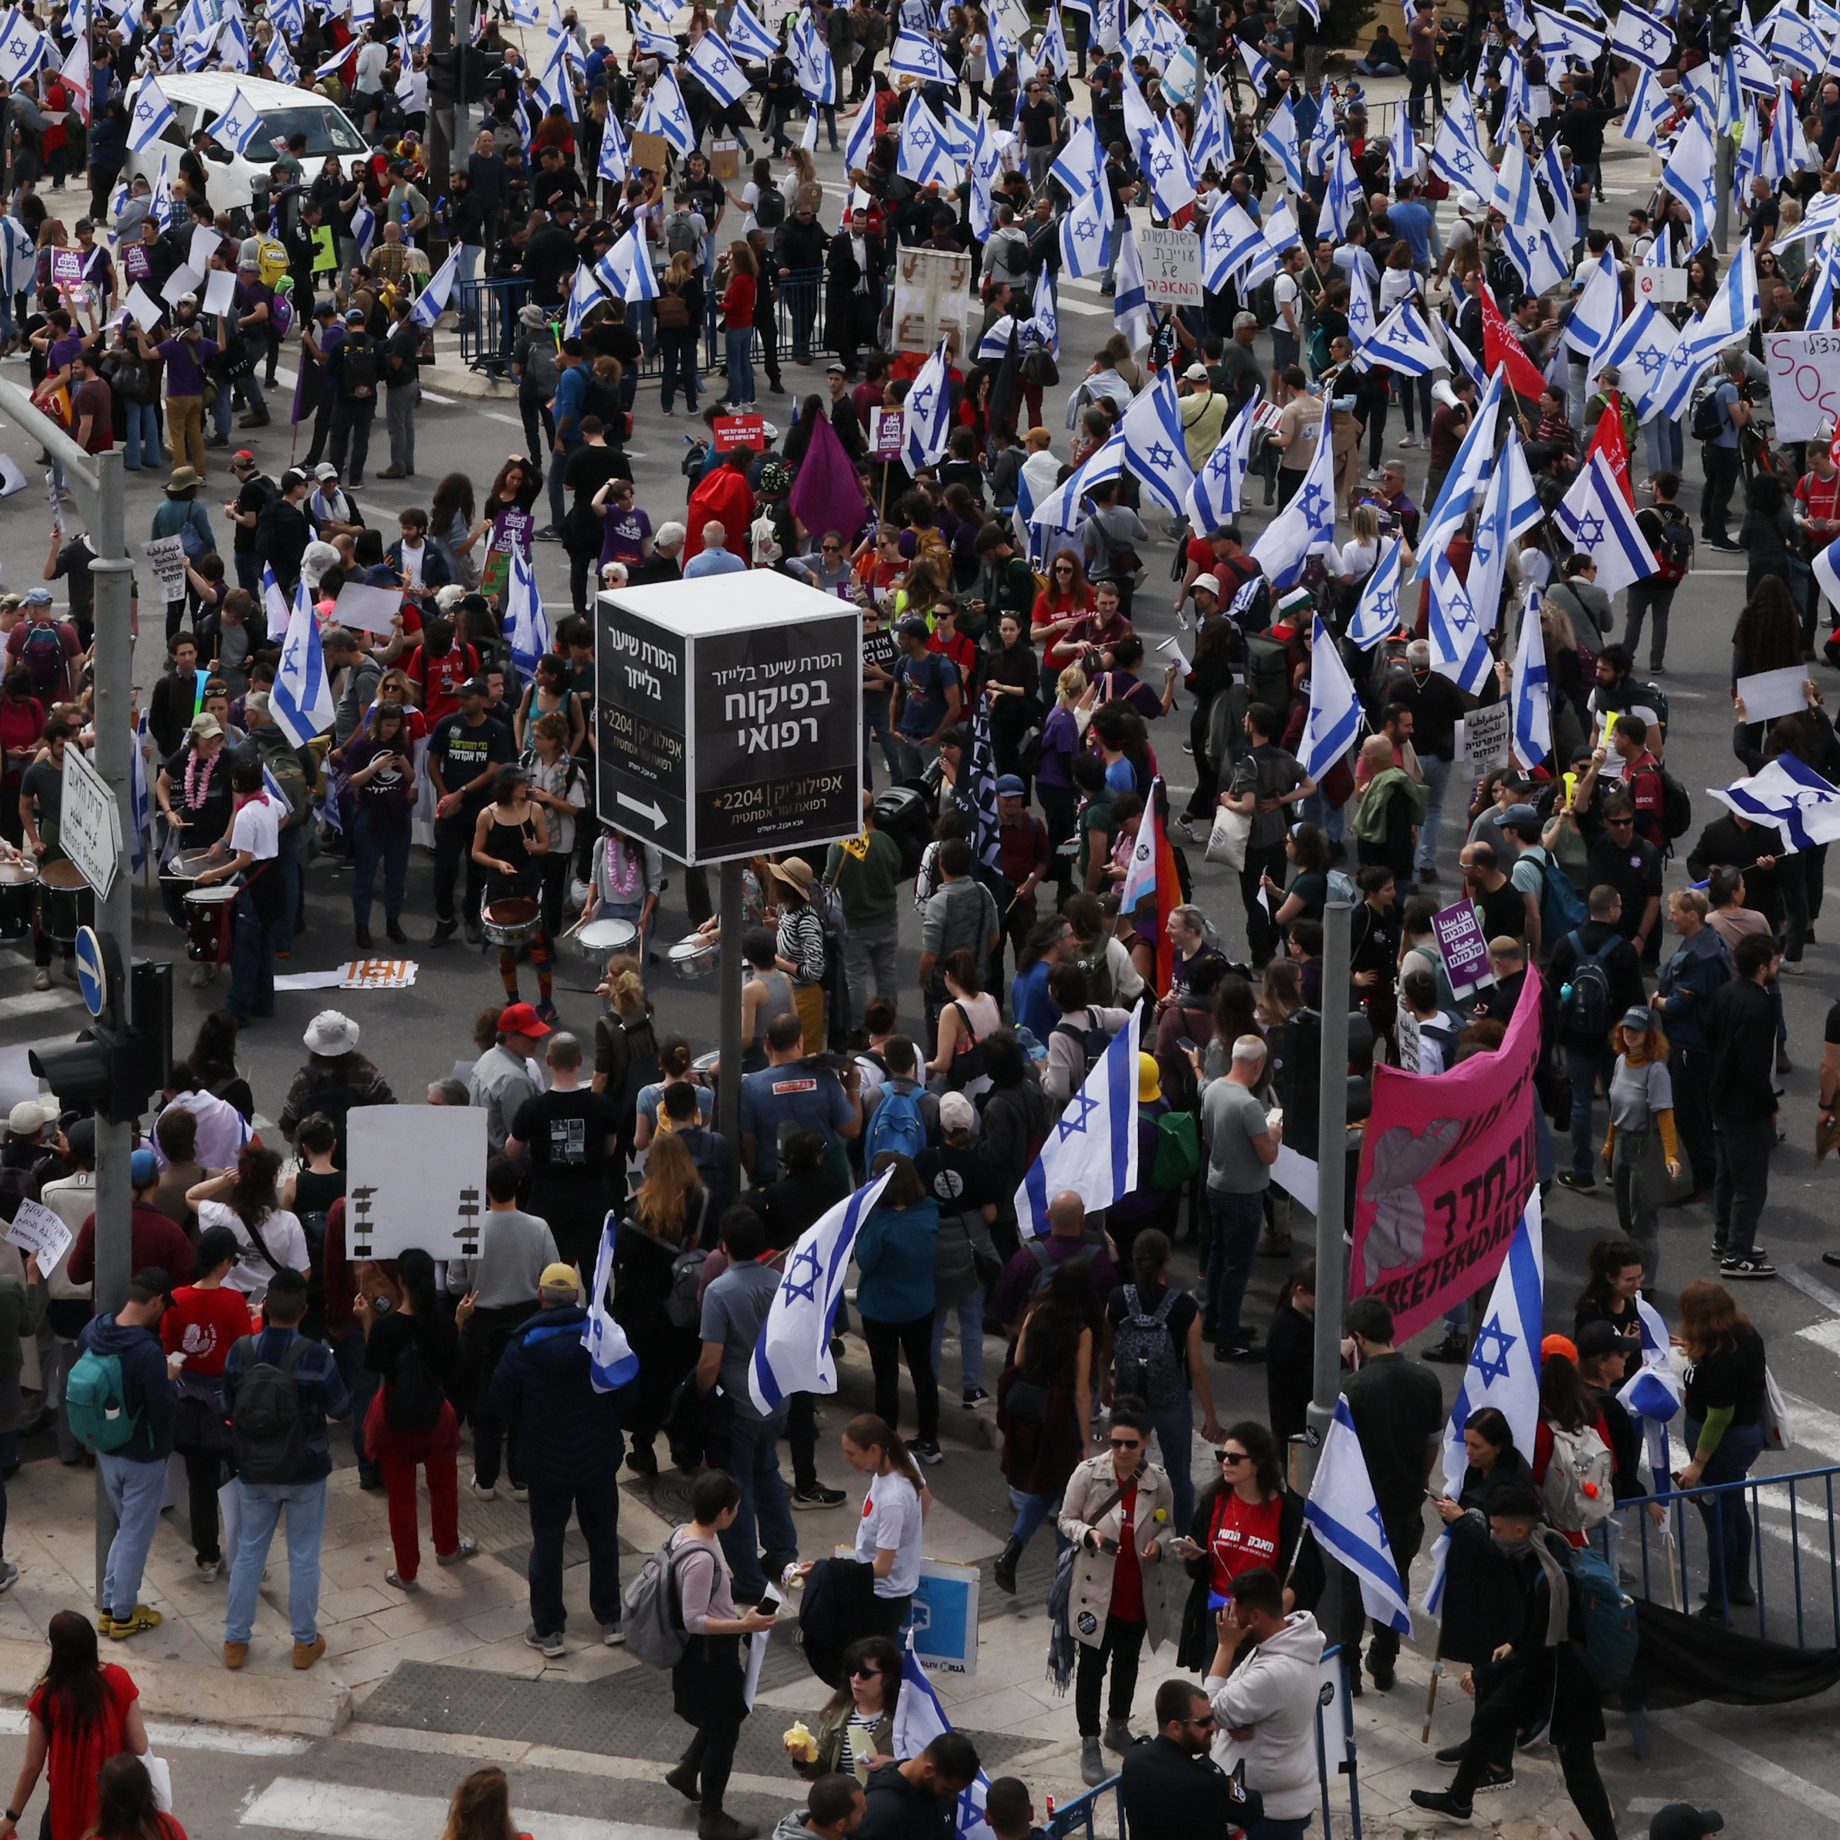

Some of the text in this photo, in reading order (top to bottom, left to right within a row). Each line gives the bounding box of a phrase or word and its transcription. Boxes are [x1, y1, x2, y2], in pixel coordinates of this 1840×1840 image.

[1162, 262, 1178, 277] של
[1146, 280, 1200, 296] המאפיה
[1803, 333, 1840, 355] הצילו
[153, 564, 184, 578] מוקרטיה
[608, 626, 678, 676] הסרת שיער
[876, 636, 890, 649] אין
[876, 648, 893, 660] עם
[711, 653, 843, 686] הסרת שיער בלייזר
[624, 665, 662, 701] בלייזר
[724, 678, 831, 724] בפיקוח
[737, 717, 819, 755] רפואי
[613, 736, 639, 758] אסתטית
[650, 754, 673, 773] רפואת
[67, 764, 103, 829] קרית הלאום
[800, 798, 827, 813] רפואת
[731, 807, 773, 825] אסתטית
[61, 817, 106, 887] National Precinct
[1443, 921, 1476, 942] זה הבית
[1449, 943, 1483, 968] של כולנו
[1218, 1528, 1241, 1543] הנשי
[1247, 1535, 1275, 1553] מאבק
